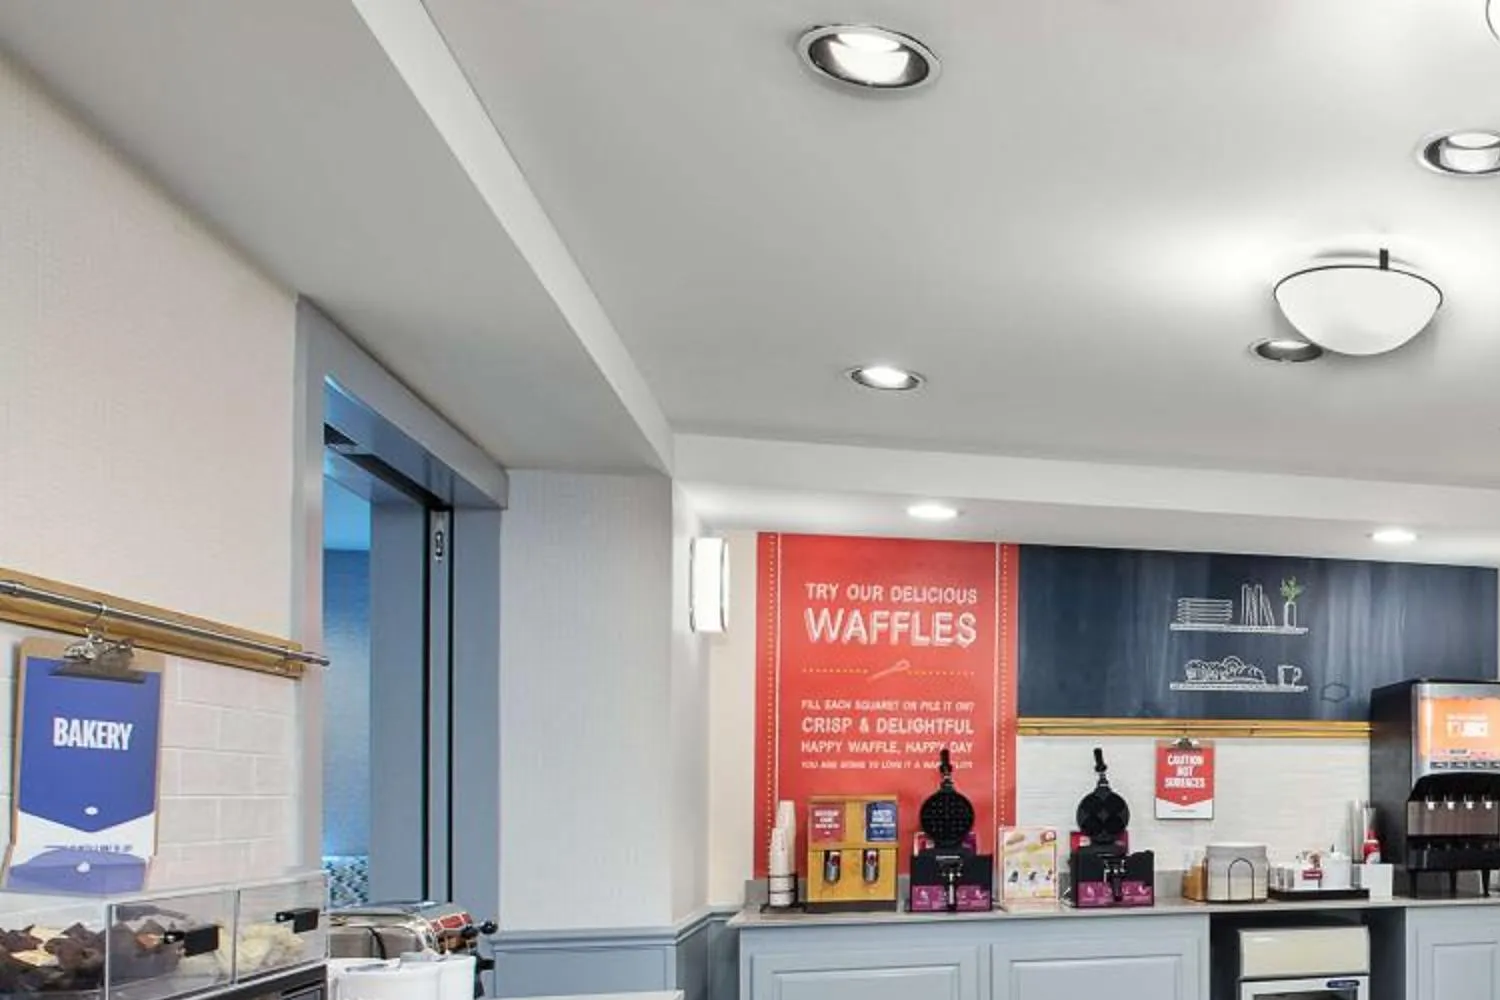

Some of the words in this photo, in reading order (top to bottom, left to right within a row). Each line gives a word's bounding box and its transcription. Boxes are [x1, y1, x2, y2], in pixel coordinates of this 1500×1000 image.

[804, 582, 839, 601] TRY
[846, 583, 884, 601] OUR
[891, 585, 977, 605] DELICIOUS
[803, 607, 977, 647] WAFFLES
[53, 717, 133, 751] BAKERY
[801, 716, 852, 733] CRISP
[876, 717, 975, 735] DELIGHTFUL
[801, 740, 842, 753] HAPPY
[950, 742, 974, 753] DAY
